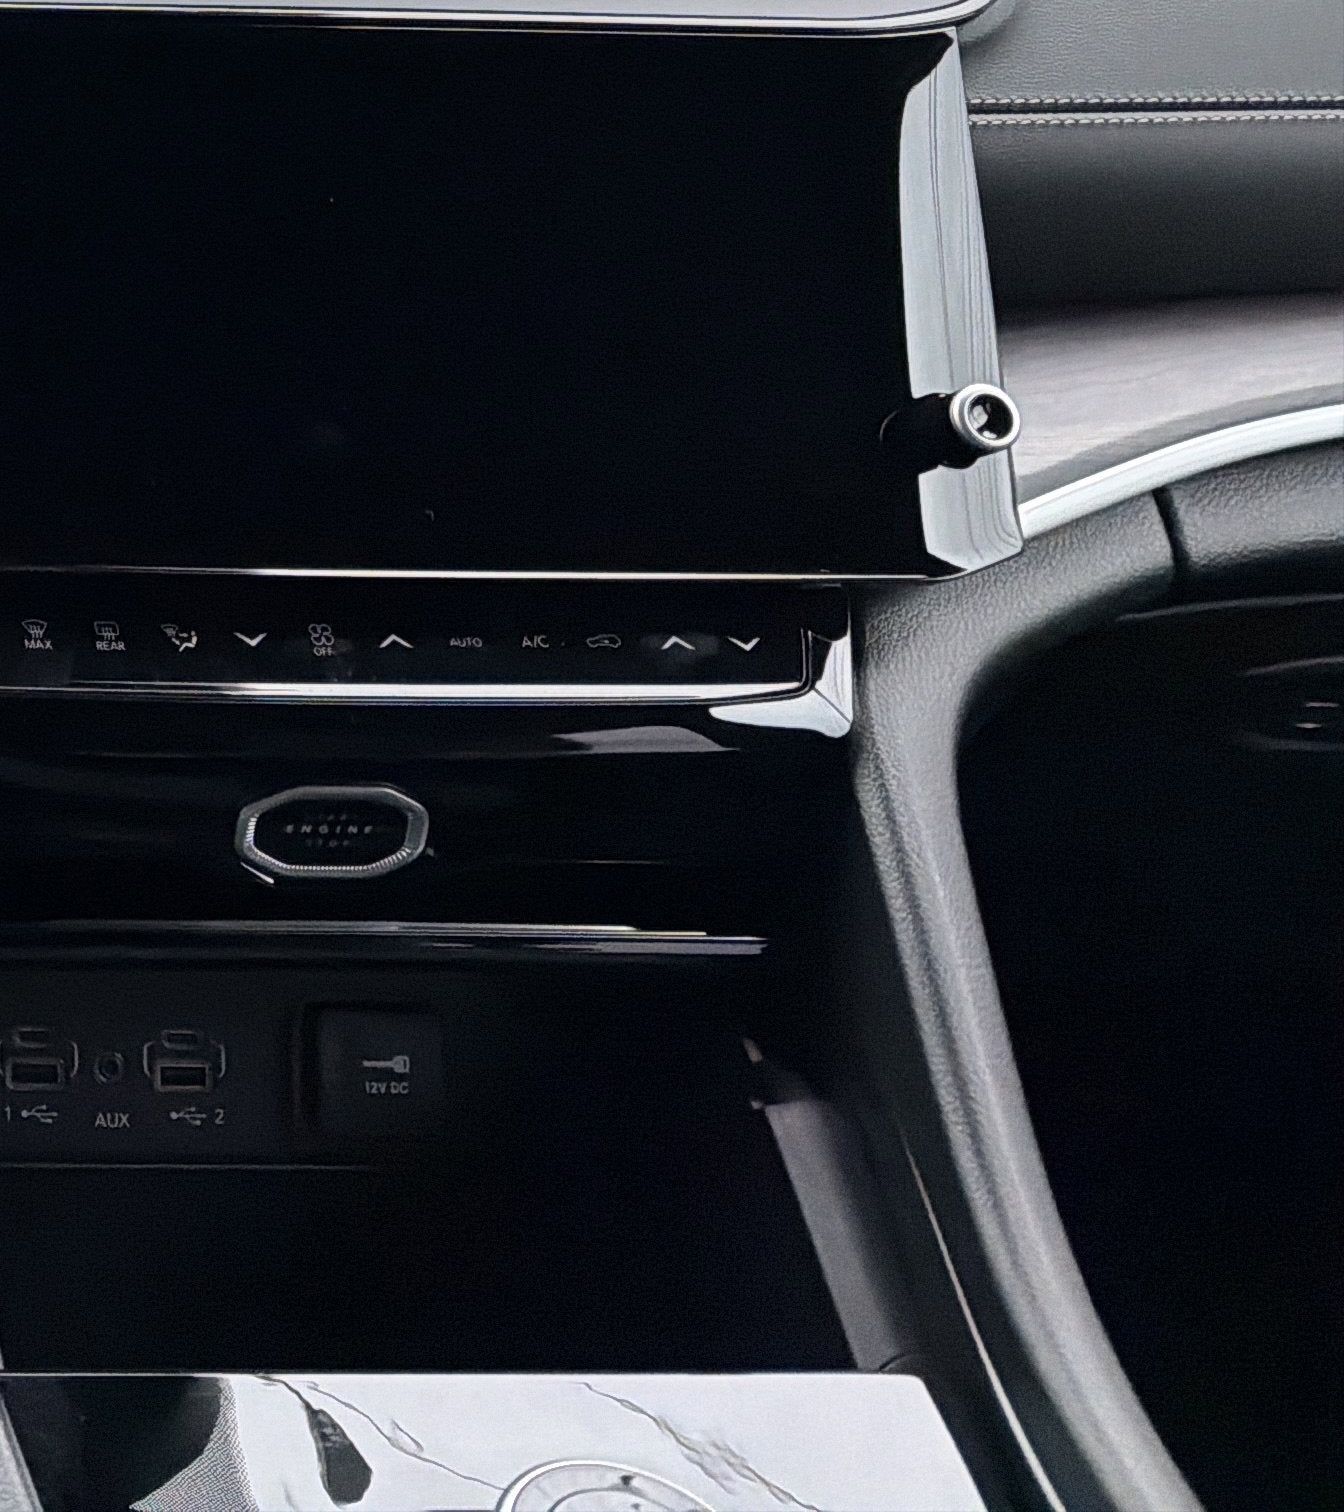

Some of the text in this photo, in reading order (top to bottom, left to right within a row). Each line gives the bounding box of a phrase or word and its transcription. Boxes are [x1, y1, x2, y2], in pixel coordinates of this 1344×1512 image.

[24, 639, 53, 651] MAX
[96, 640, 126, 652] REAR
[449, 636, 482, 648] AUTO
[522, 635, 550, 649] A/C
[285, 823, 373, 836] ENGINE
[364, 1080, 411, 1094] 12V DC
[94, 1111, 132, 1128] AUX
[213, 1108, 226, 1125] 2
